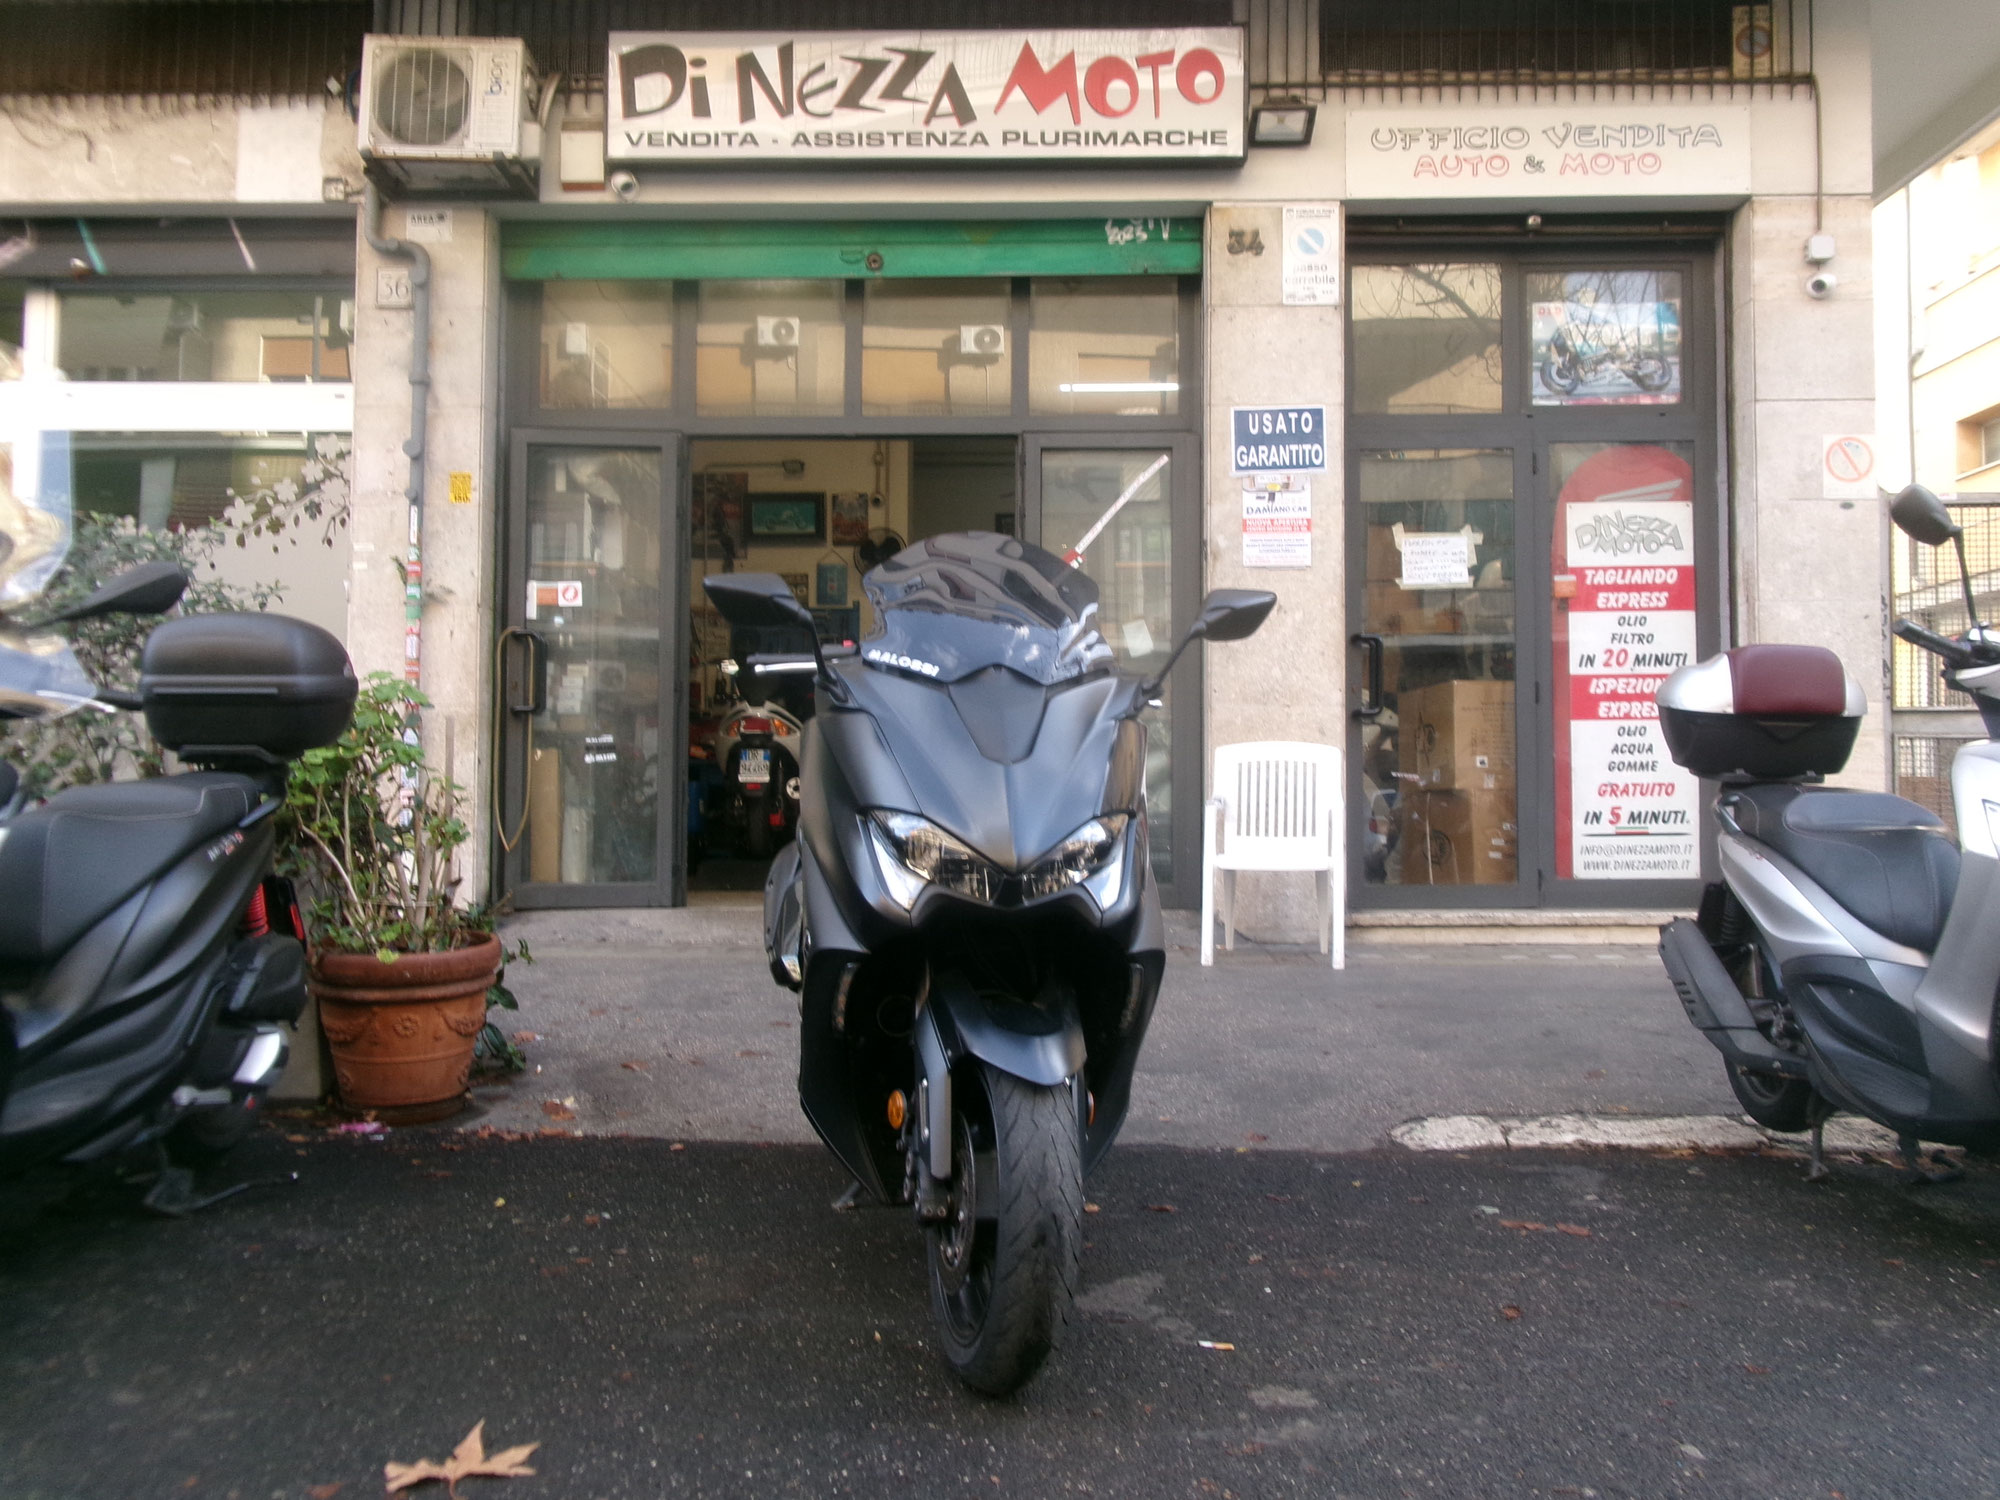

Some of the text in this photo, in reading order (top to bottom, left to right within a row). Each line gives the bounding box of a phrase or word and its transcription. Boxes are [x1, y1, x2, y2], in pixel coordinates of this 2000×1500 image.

[993, 39, 1225, 125] MOTO
[624, 131, 760, 147] VENDITA
[790, 130, 990, 148] ASSISTENZA
[1001, 129, 1229, 147] PLURIMARCHE
[1370, 122, 1723, 152] UFFICIO VENDITA
[1413, 152, 1662, 178] AUTO & MOTO
[381, 273, 409, 299] 36
[1248, 412, 1313, 435] USATO
[1236, 443, 1323, 468] GARANTITO
[1594, 531, 1662, 556] MOTO
[1585, 568, 1678, 586] TAGLIANDO
[1596, 592, 1669, 610] EXPRESS
[1617, 616, 1647, 627] OLIO
[1611, 633, 1654, 645] FILTRO
[868, 648, 940, 678] MALOSSI
[1578, 648, 1688, 669] IN 20 MINUTI
[1598, 701, 1659, 718] EXPRES
[1617, 725, 1647, 737] OLIO
[1611, 743, 1654, 755] ACQUA
[1608, 760, 1659, 772] GOMME
[1598, 782, 1675, 797] GRATUITO
[1583, 811, 1602, 824] IN
[1608, 806, 1622, 825] 5
[1583, 860, 1691, 871] WWW.DINEZZAMOTO.IT
